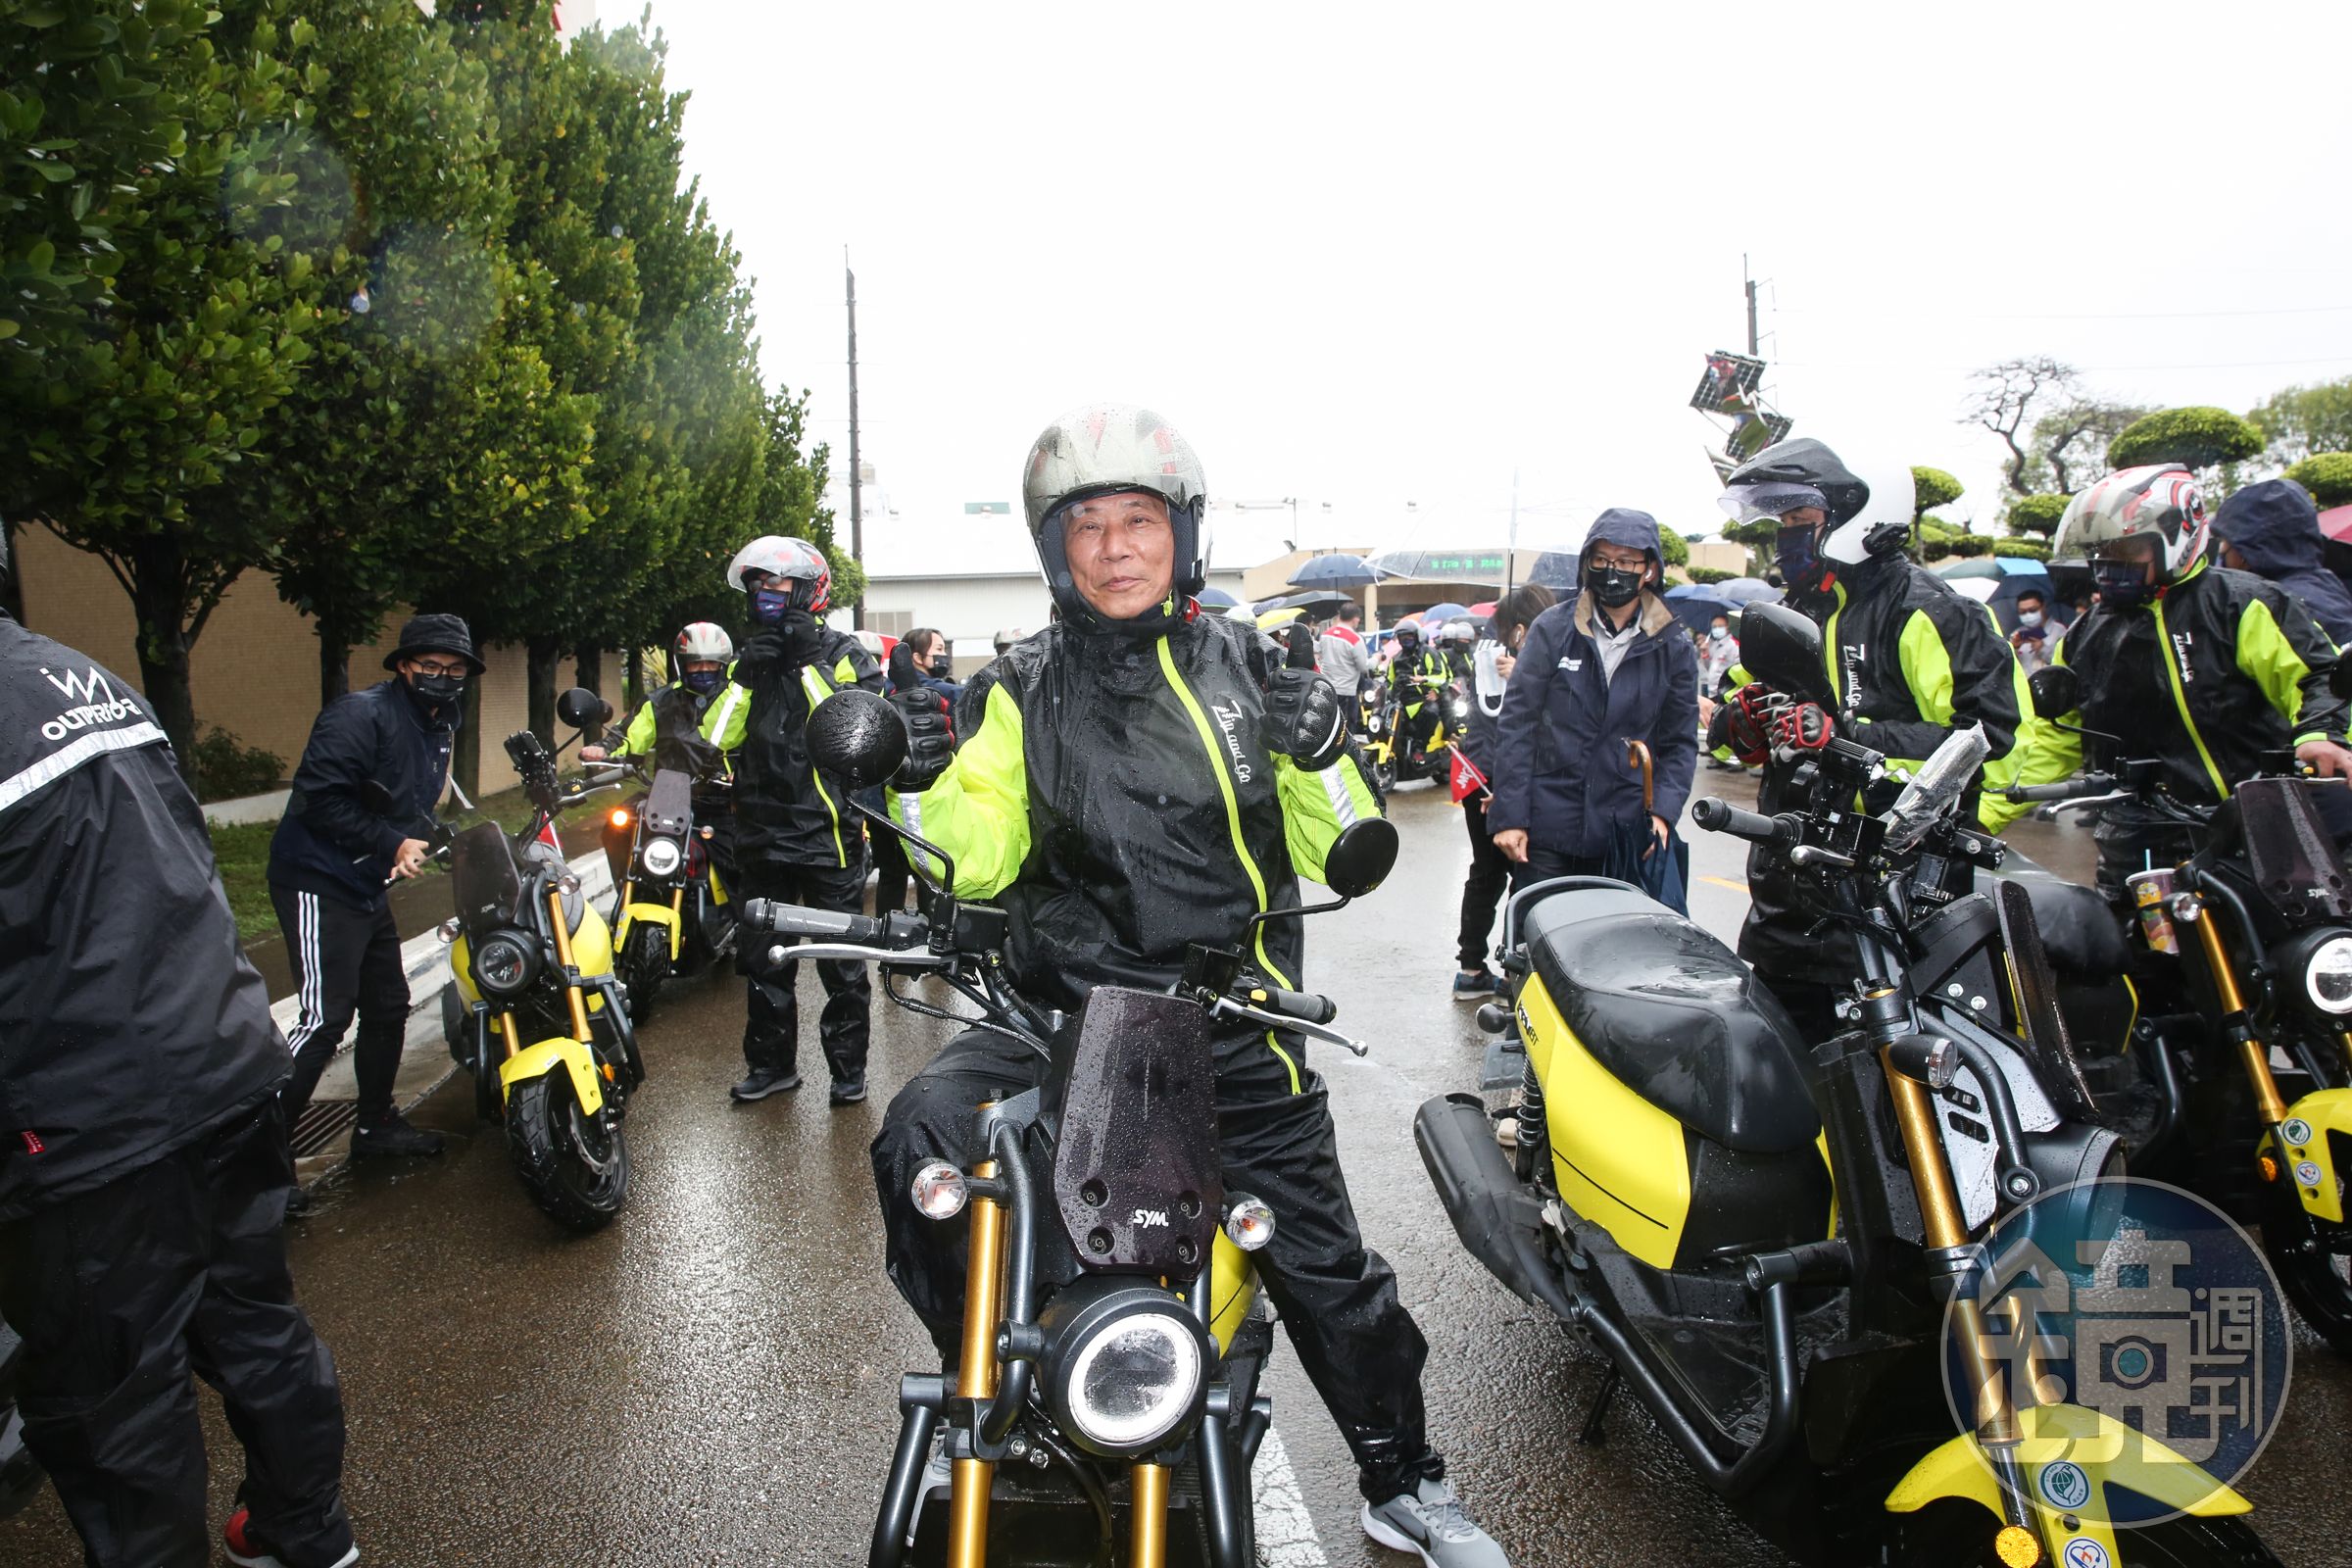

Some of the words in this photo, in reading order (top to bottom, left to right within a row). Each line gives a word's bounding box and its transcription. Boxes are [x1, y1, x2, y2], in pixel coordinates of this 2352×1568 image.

[1211, 700, 1244, 734] Zip
[1225, 733, 1247, 760] and
[1234, 763, 1251, 784] Go
[1133, 1208, 1169, 1229] SYM
